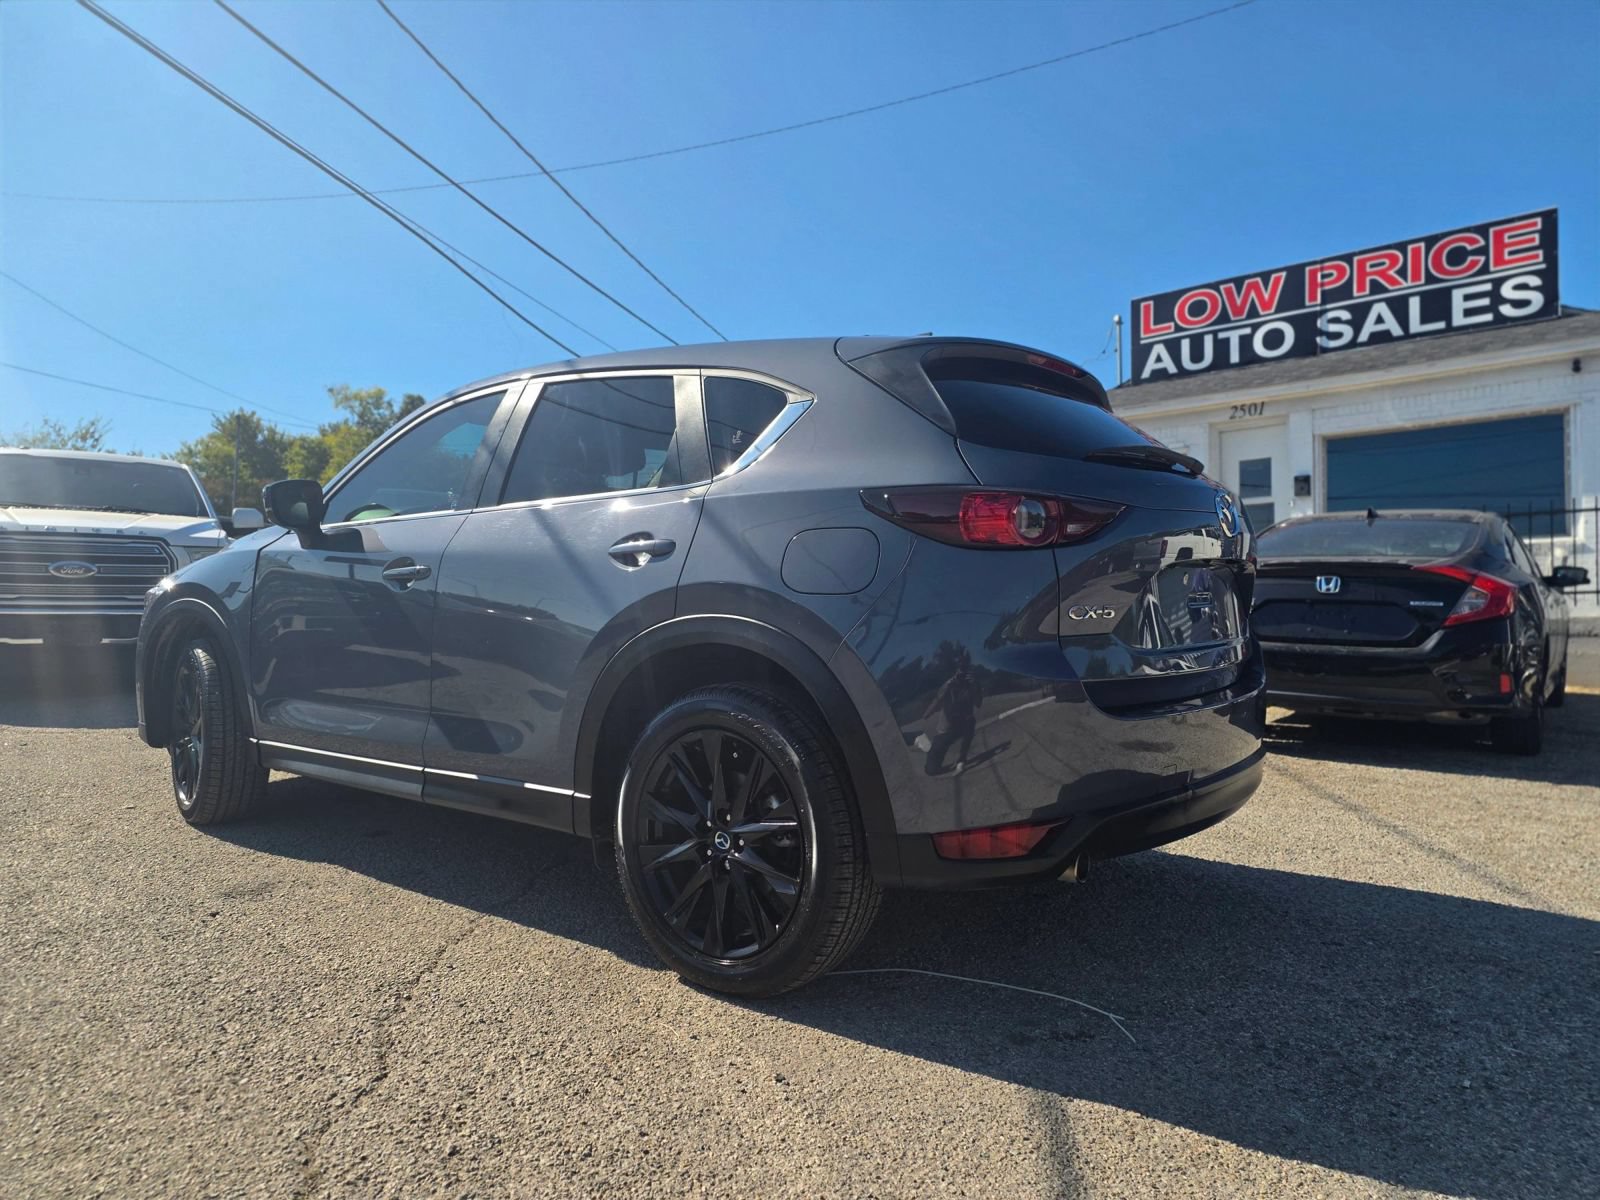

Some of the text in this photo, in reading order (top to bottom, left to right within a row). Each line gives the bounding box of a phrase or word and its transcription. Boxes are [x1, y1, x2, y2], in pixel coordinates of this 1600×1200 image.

[1140, 217, 1544, 337] LOW PRICE
[1140, 274, 1545, 380] AUTO SALES
[1229, 401, 1265, 420] 2501
[1068, 605, 1116, 620] CX-5
